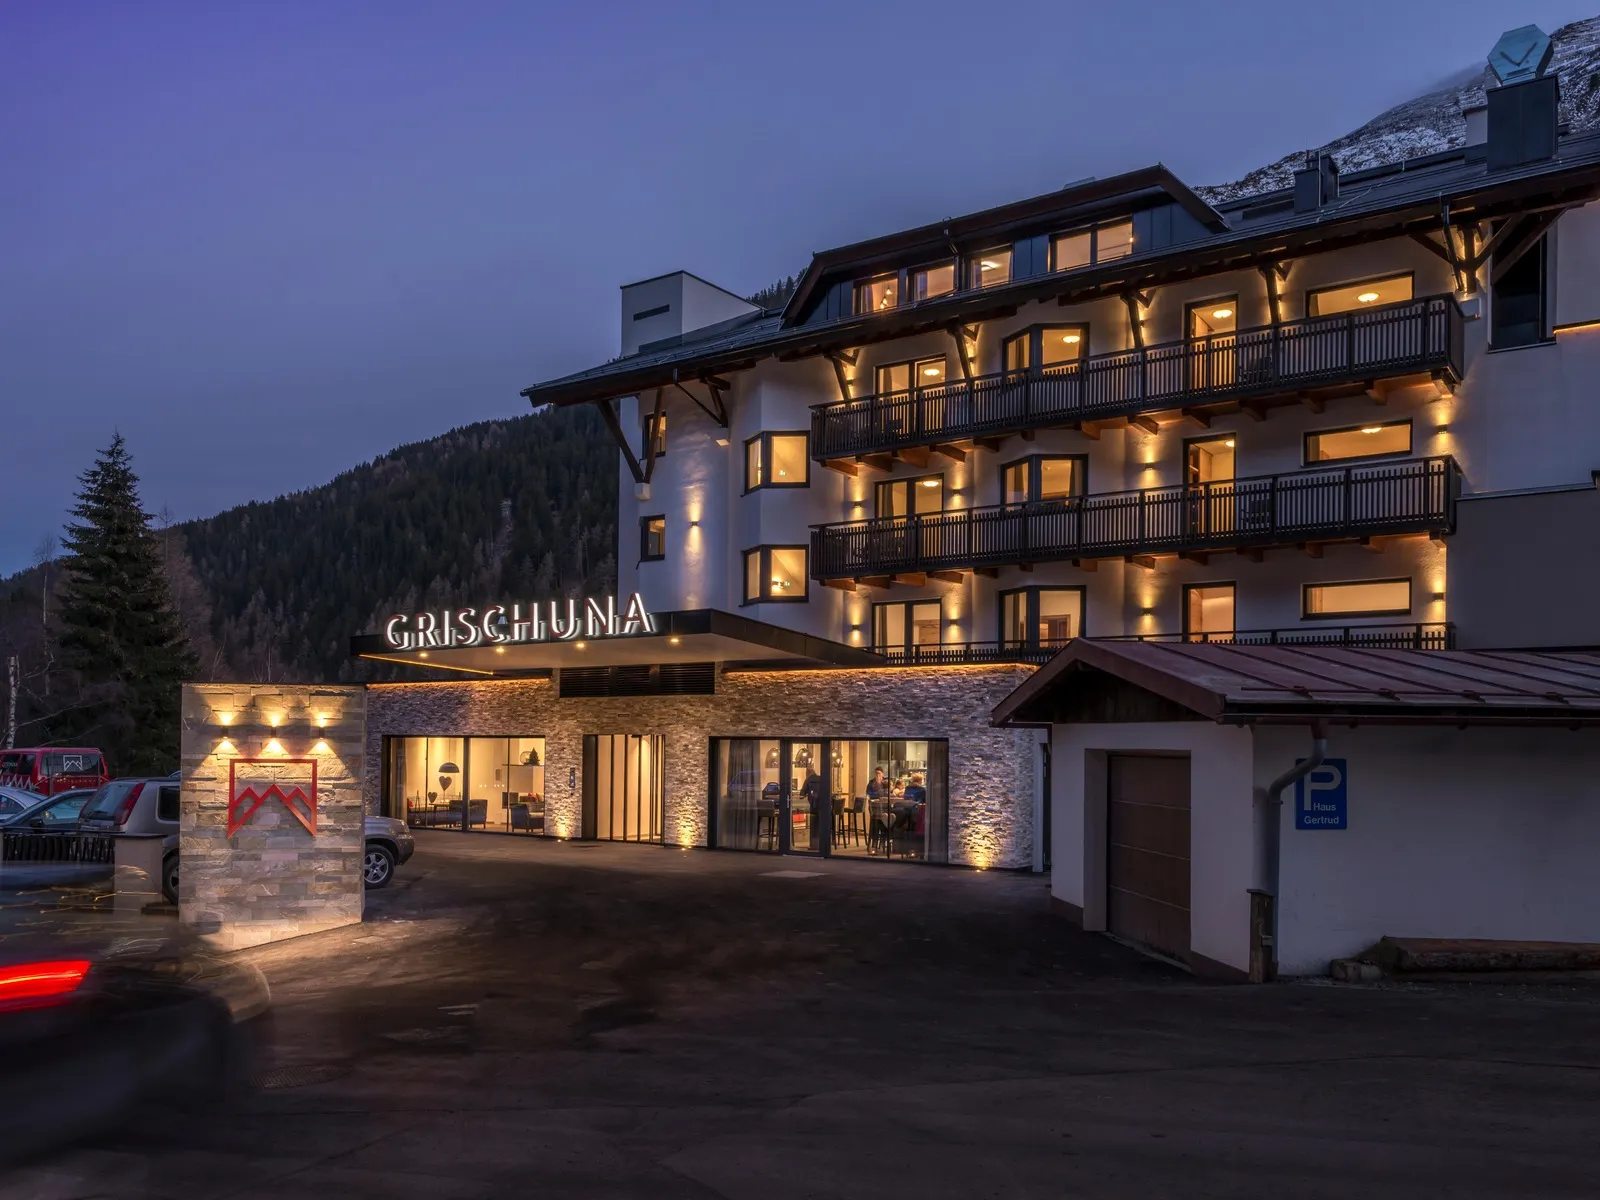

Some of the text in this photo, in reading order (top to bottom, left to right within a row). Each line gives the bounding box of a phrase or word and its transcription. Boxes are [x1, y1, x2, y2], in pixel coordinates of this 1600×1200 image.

[384, 592, 652, 650] GRISCHUNA
[1304, 765, 1341, 810] P
[1304, 815, 1340, 824] Gertrud
[1313, 802, 1337, 811] Haus
